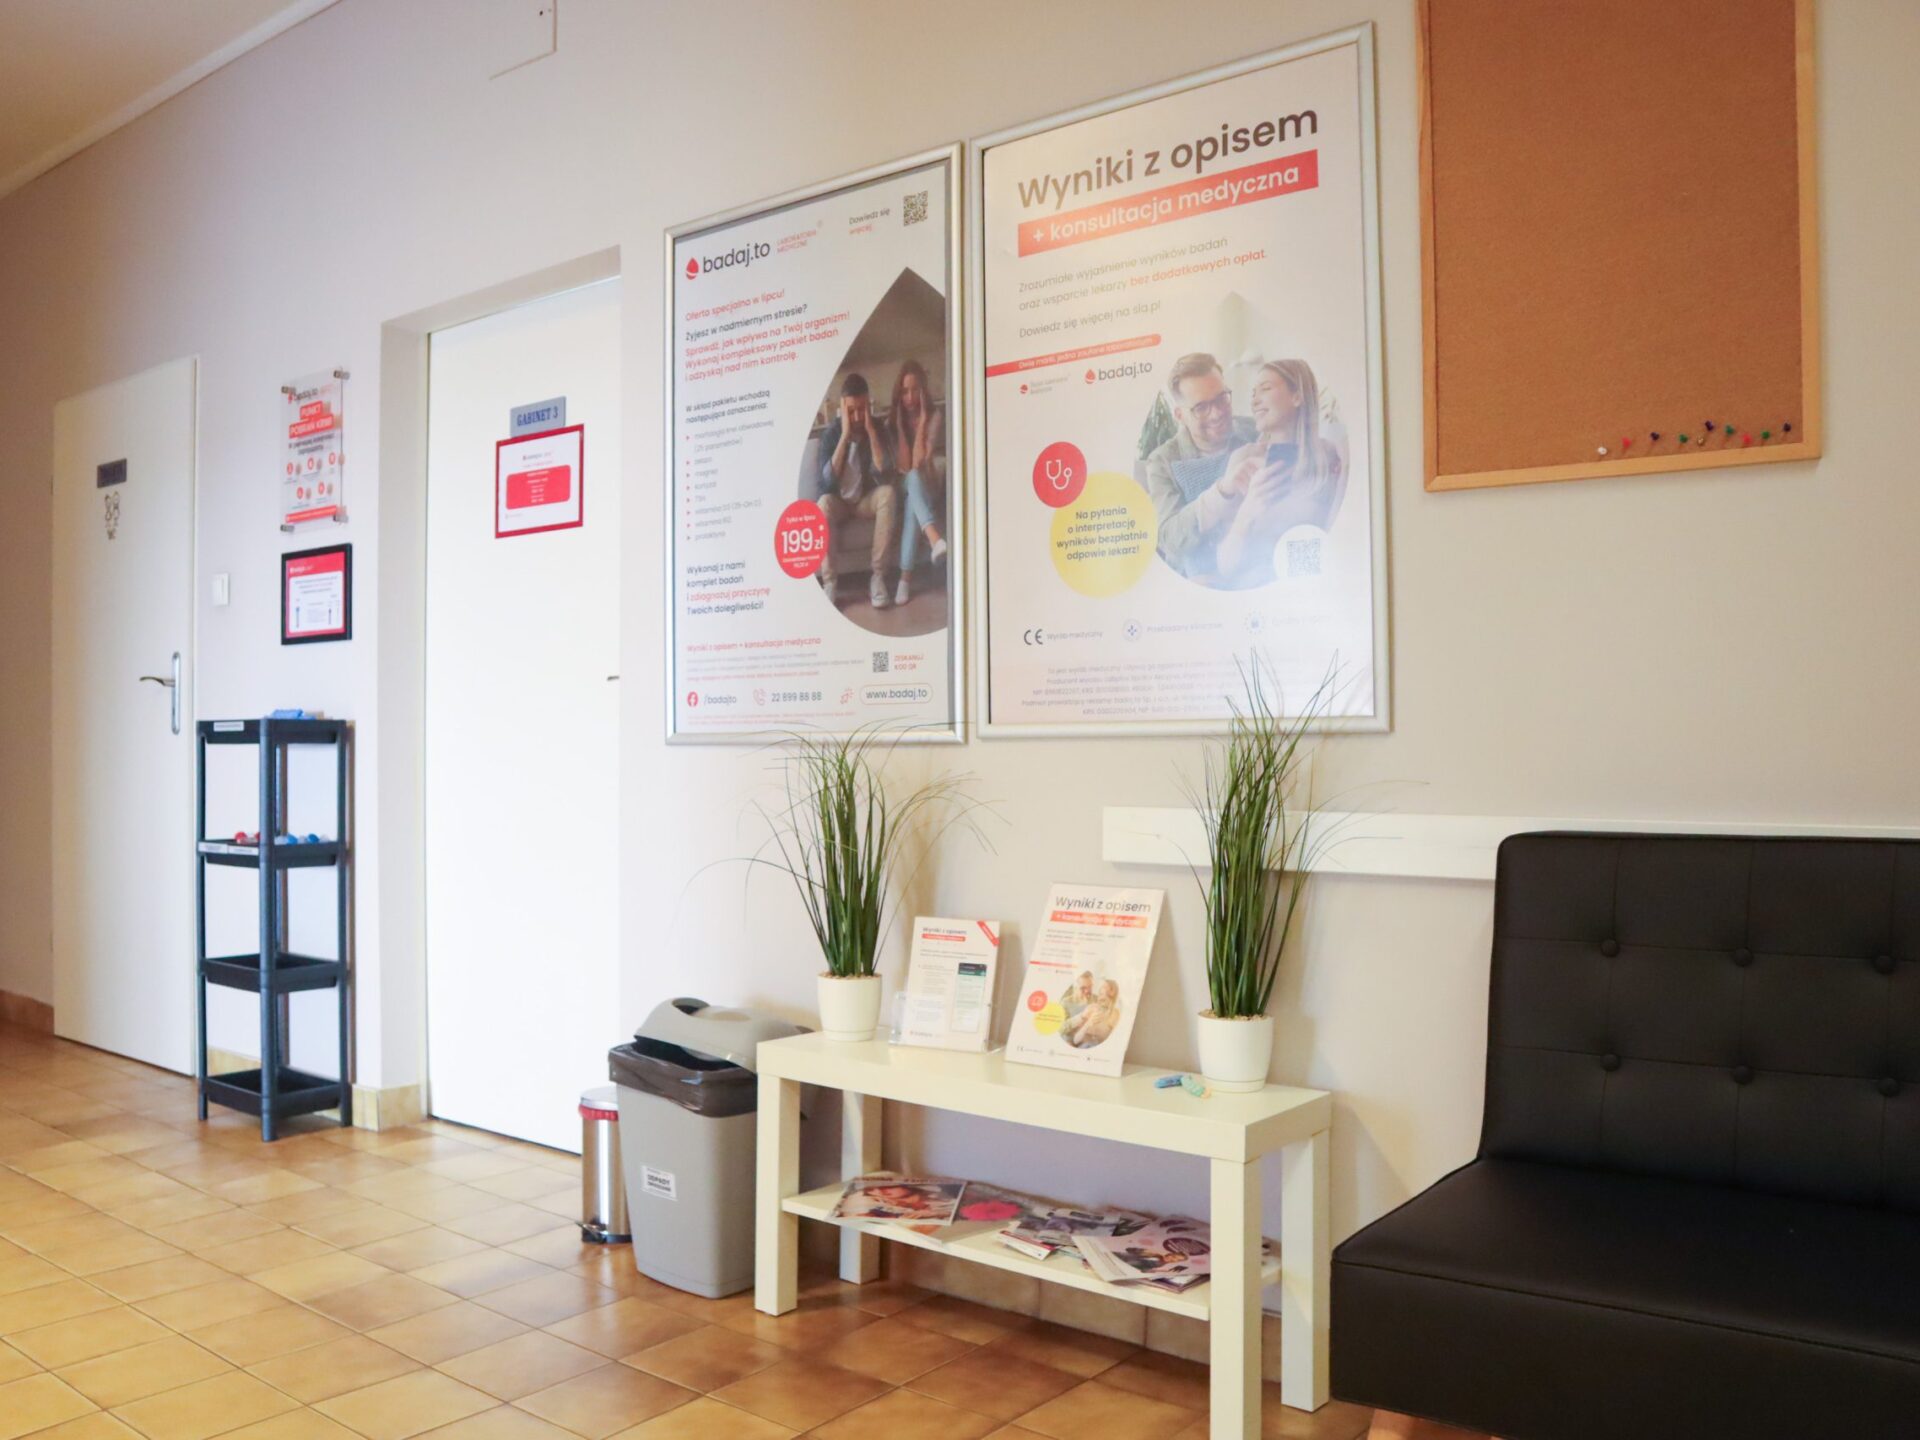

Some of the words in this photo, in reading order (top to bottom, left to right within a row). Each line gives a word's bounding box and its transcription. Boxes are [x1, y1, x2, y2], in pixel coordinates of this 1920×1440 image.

[1018, 149, 1133, 210] Wyniki
[1144, 150, 1161, 177] z
[1171, 109, 1318, 173] opisem
[1033, 230, 1044, 243] +
[1050, 195, 1172, 241] konsultacja
[1177, 164, 1299, 211] medyczna
[849, 211, 879, 225] Dowiedz
[703, 243, 770, 274] badaj.to
[1019, 273, 1074, 293] Zrozumiałe
[1076, 257, 1137, 281] wyjaśnienie
[1139, 246, 1186, 267] wyników
[1189, 237, 1228, 255] badań
[1019, 298, 1041, 311] oraz
[1043, 287, 1089, 307] wsparcie
[1091, 280, 1127, 297] lekarzy
[1130, 275, 1150, 287] bez
[1152, 255, 1231, 283] dodatkowych
[686, 309, 710, 321] Oferta
[712, 300, 751, 316] specjalna
[761, 289, 785, 304] lipcu!
[718, 314, 772, 332] nadmiernym
[774, 304, 808, 320] stresie?
[1019, 319, 1061, 338] Dowiedz
[1064, 316, 1077, 329] się
[1080, 309, 1114, 327] więcej
[1116, 306, 1130, 317] na
[722, 337, 734, 350] jak
[736, 331, 768, 346] wpływa
[770, 328, 781, 337] na
[783, 323, 803, 336] Twój
[805, 311, 850, 329] organizm!
[685, 355, 720, 370] Wykonaj
[721, 341, 777, 361] kompleksowy
[780, 334, 808, 350] pakiet
[689, 366, 723, 382] odzyskaj
[724, 361, 741, 372] nad
[742, 359, 759, 369] nim
[1098, 361, 1153, 381] badaj.to
[517, 408, 551, 427] GABINET
[553, 406, 559, 419] 3
[1075, 511, 1088, 519] Na
[1090, 506, 1127, 520] pytania
[1067, 526, 1074, 534] o
[1076, 519, 1136, 532] interpretację
[781, 527, 813, 555] 199
[814, 535, 824, 550] zł
[1056, 537, 1097, 549] wyników
[1098, 530, 1148, 544] bezpłatnie
[1066, 549, 1106, 562] odpowie
[1108, 545, 1140, 556] lekarz!
[687, 565, 719, 576] Wykonaj
[720, 563, 724, 571] z
[725, 561, 745, 570] nami
[687, 578, 718, 588] komplet
[687, 605, 713, 615] Twoich
[771, 692, 781, 702] 22
[782, 691, 797, 702] 899
[799, 691, 810, 702] 88
[812, 691, 822, 701] 88
[866, 687, 928, 700] www.badaj.to
[1055, 896, 1095, 910] Wyniki
[1097, 901, 1103, 909] z
[1106, 900, 1151, 913] opisem
